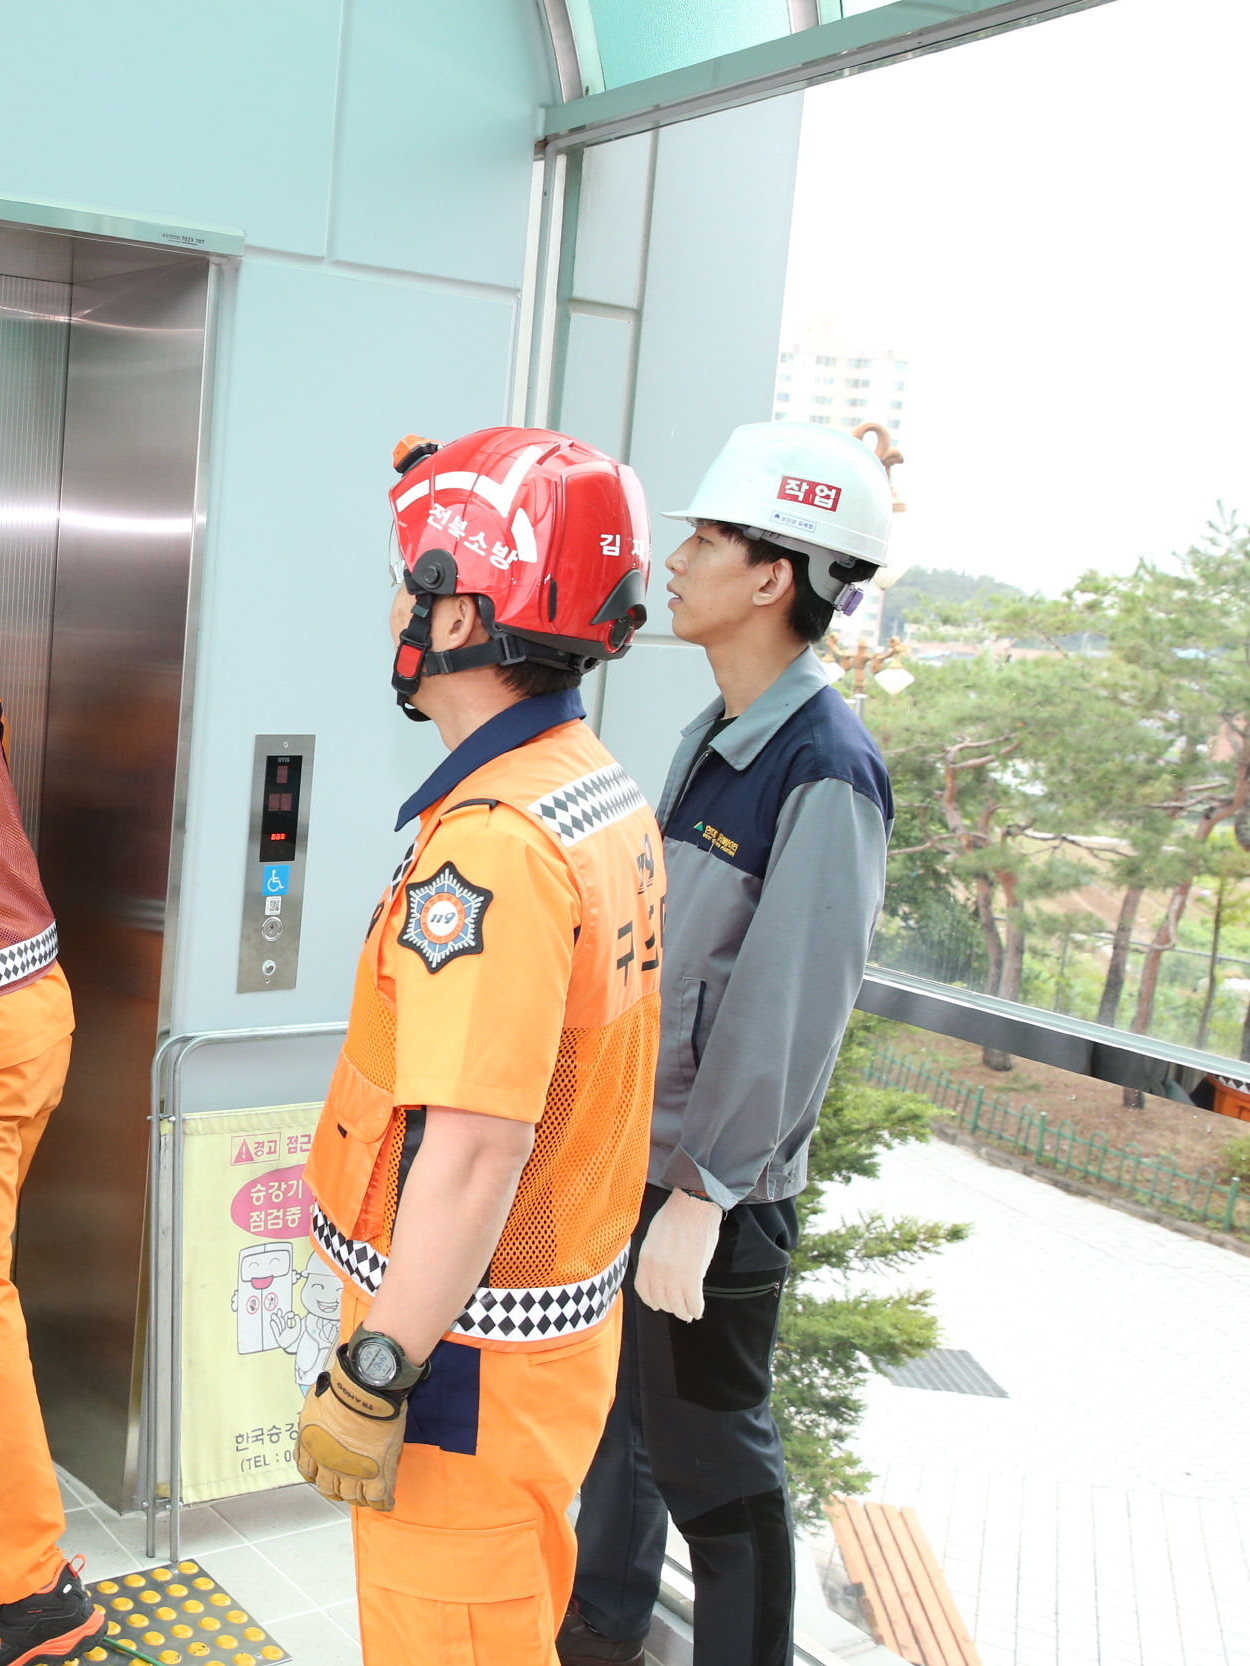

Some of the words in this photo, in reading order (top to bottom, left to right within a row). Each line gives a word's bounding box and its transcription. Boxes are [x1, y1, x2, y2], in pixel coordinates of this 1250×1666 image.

[784, 479, 837, 509] 작업
[426, 502, 519, 570] 전북소방
[599, 533, 652, 562] 김재
[429, 911, 457, 925] 119
[254, 1140, 278, 1157] 경고
[250, 1179, 303, 1206] 승강기
[240, 1454, 271, 1473] (TEL
